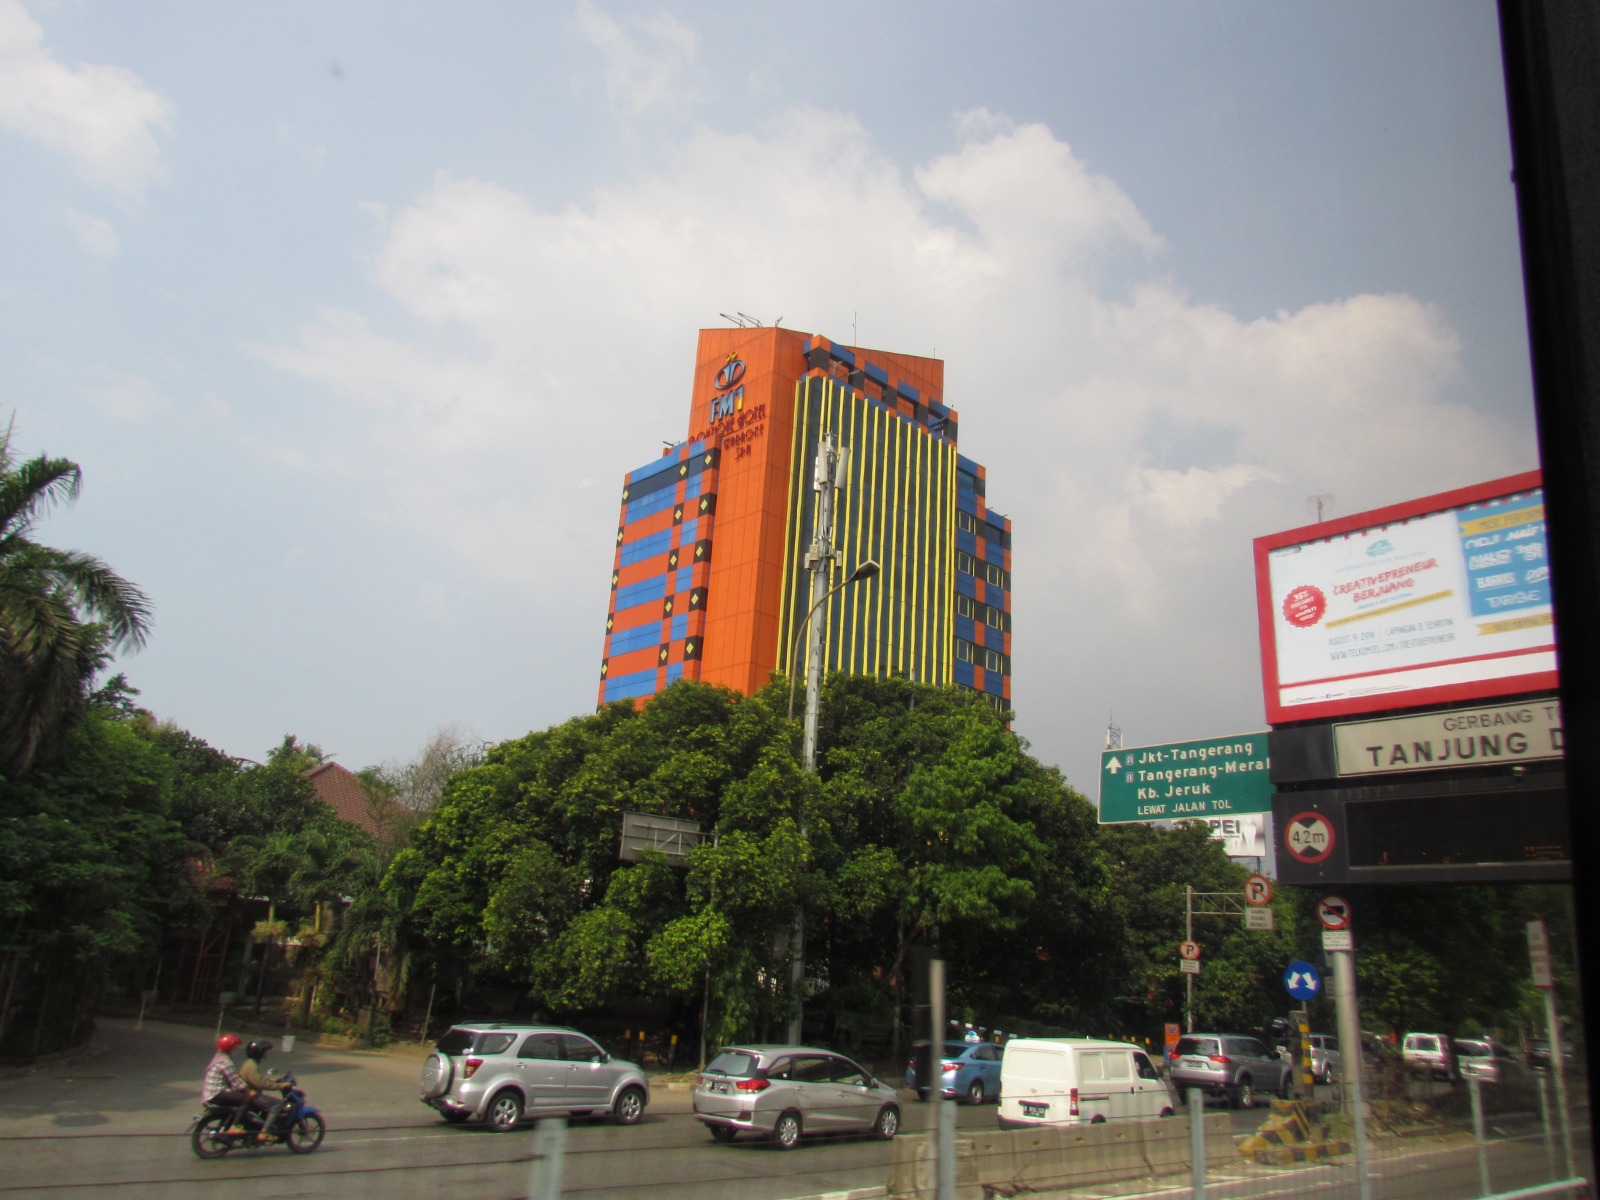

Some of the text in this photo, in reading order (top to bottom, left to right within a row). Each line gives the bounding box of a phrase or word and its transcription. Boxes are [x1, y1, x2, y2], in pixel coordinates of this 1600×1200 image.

[1333, 558, 1440, 596] CREATIVEPRENEUR
[1353, 578, 1416, 603] BERJUANG
[1443, 709, 1533, 731] GERBANG
[1138, 742, 1253, 764] Jkt-Tangerang
[1366, 732, 1528, 767] TANJUNG
[1137, 783, 1212, 800] Kb. Jeruk
[1137, 799, 1232, 815] LEWAT JALAN TOL
